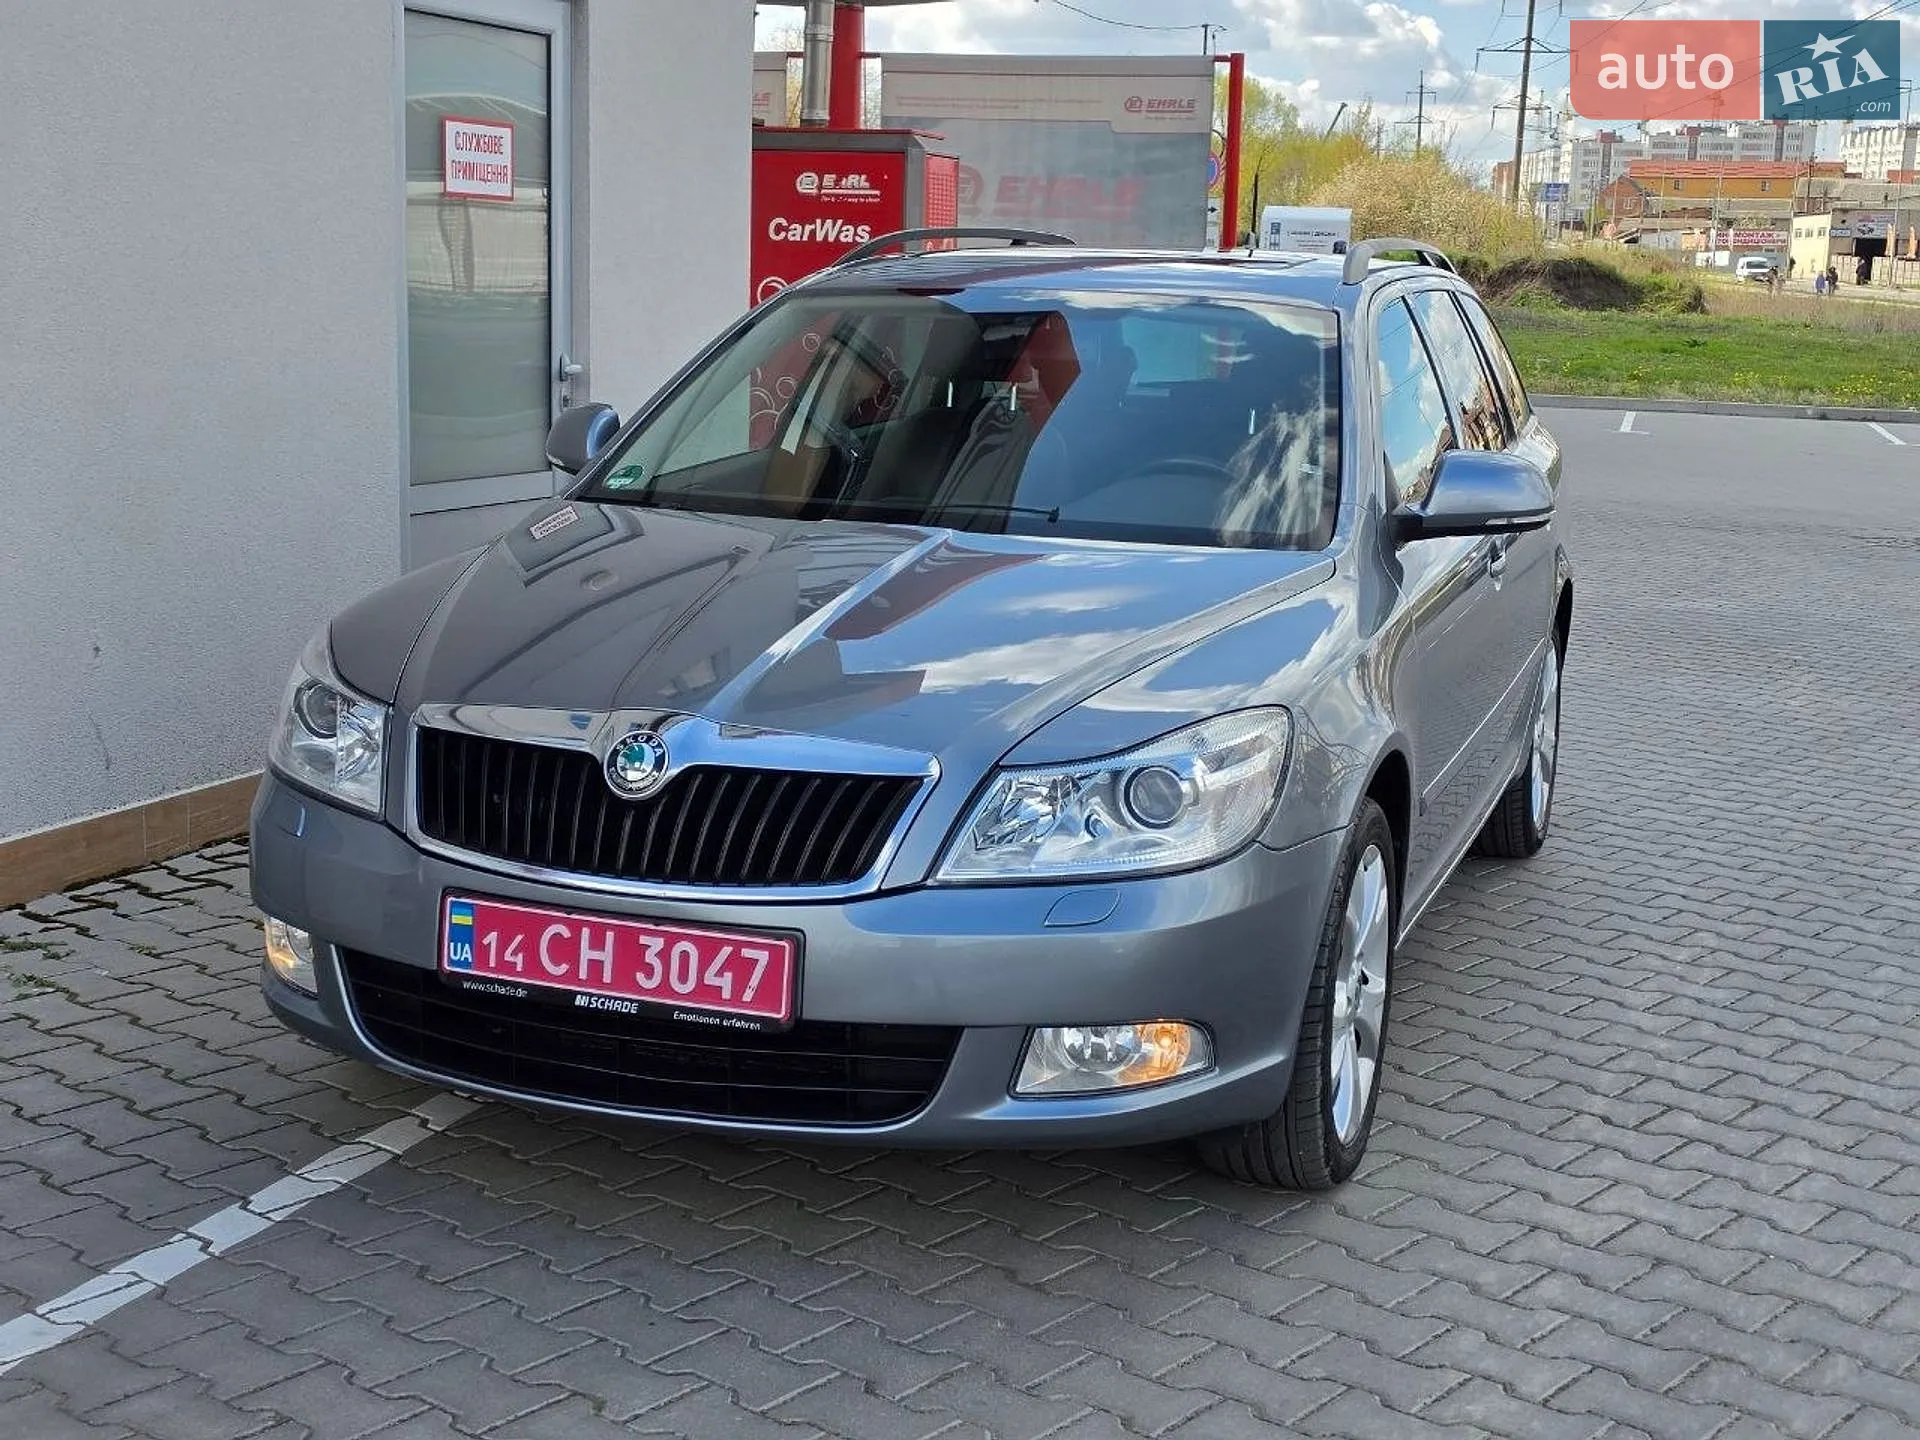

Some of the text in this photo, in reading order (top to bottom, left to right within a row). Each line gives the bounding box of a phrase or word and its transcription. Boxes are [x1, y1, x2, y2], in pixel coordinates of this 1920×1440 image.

[1147, 98, 1196, 108] EHRLE
[454, 130, 504, 155] СЛУЖБОВЕ
[451, 160, 509, 184] ПРИМІЩЕННЯ
[450, 941, 472, 963] UA
[481, 923, 770, 1002] 14 CH 3047
[673, 1011, 761, 1031] Emotionen erfahren
